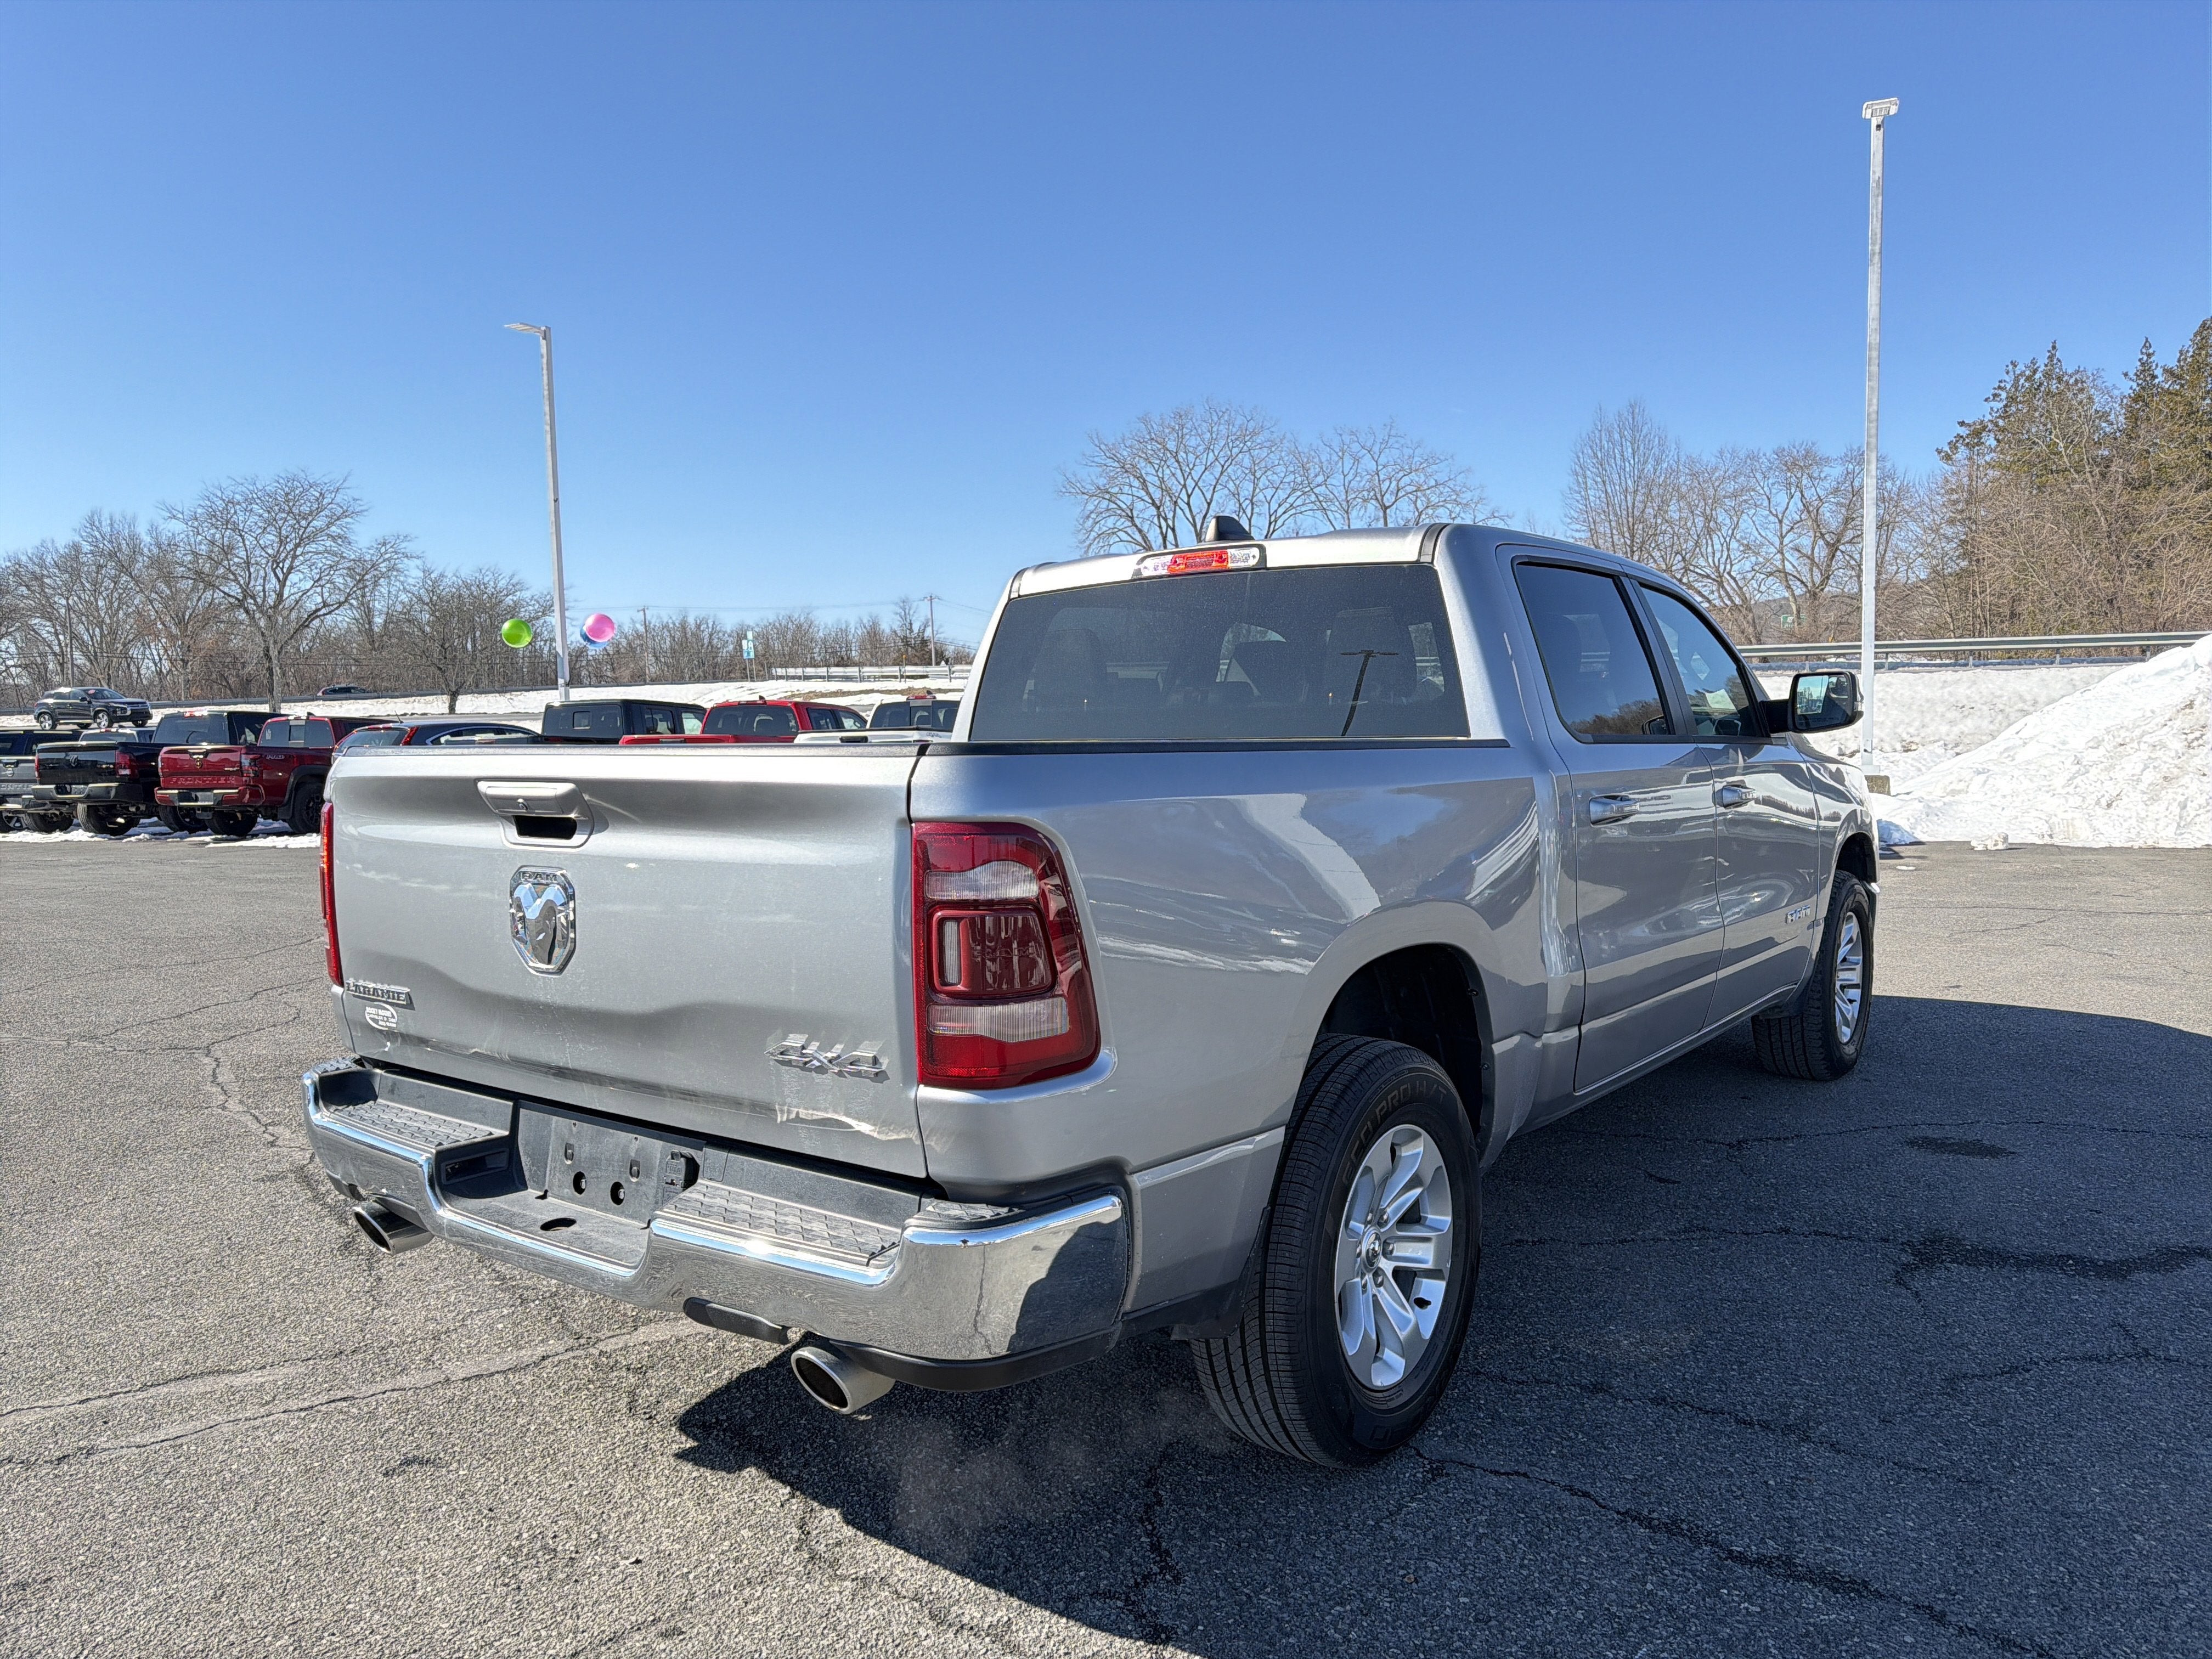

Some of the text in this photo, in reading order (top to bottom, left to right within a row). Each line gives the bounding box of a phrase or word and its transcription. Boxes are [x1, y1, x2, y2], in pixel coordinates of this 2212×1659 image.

[520, 872, 558, 883] RAM
[1785, 905, 1810, 924] RAM
[346, 981, 407, 1005] LARAMIE
[1375, 1083, 1412, 1125] PRO
